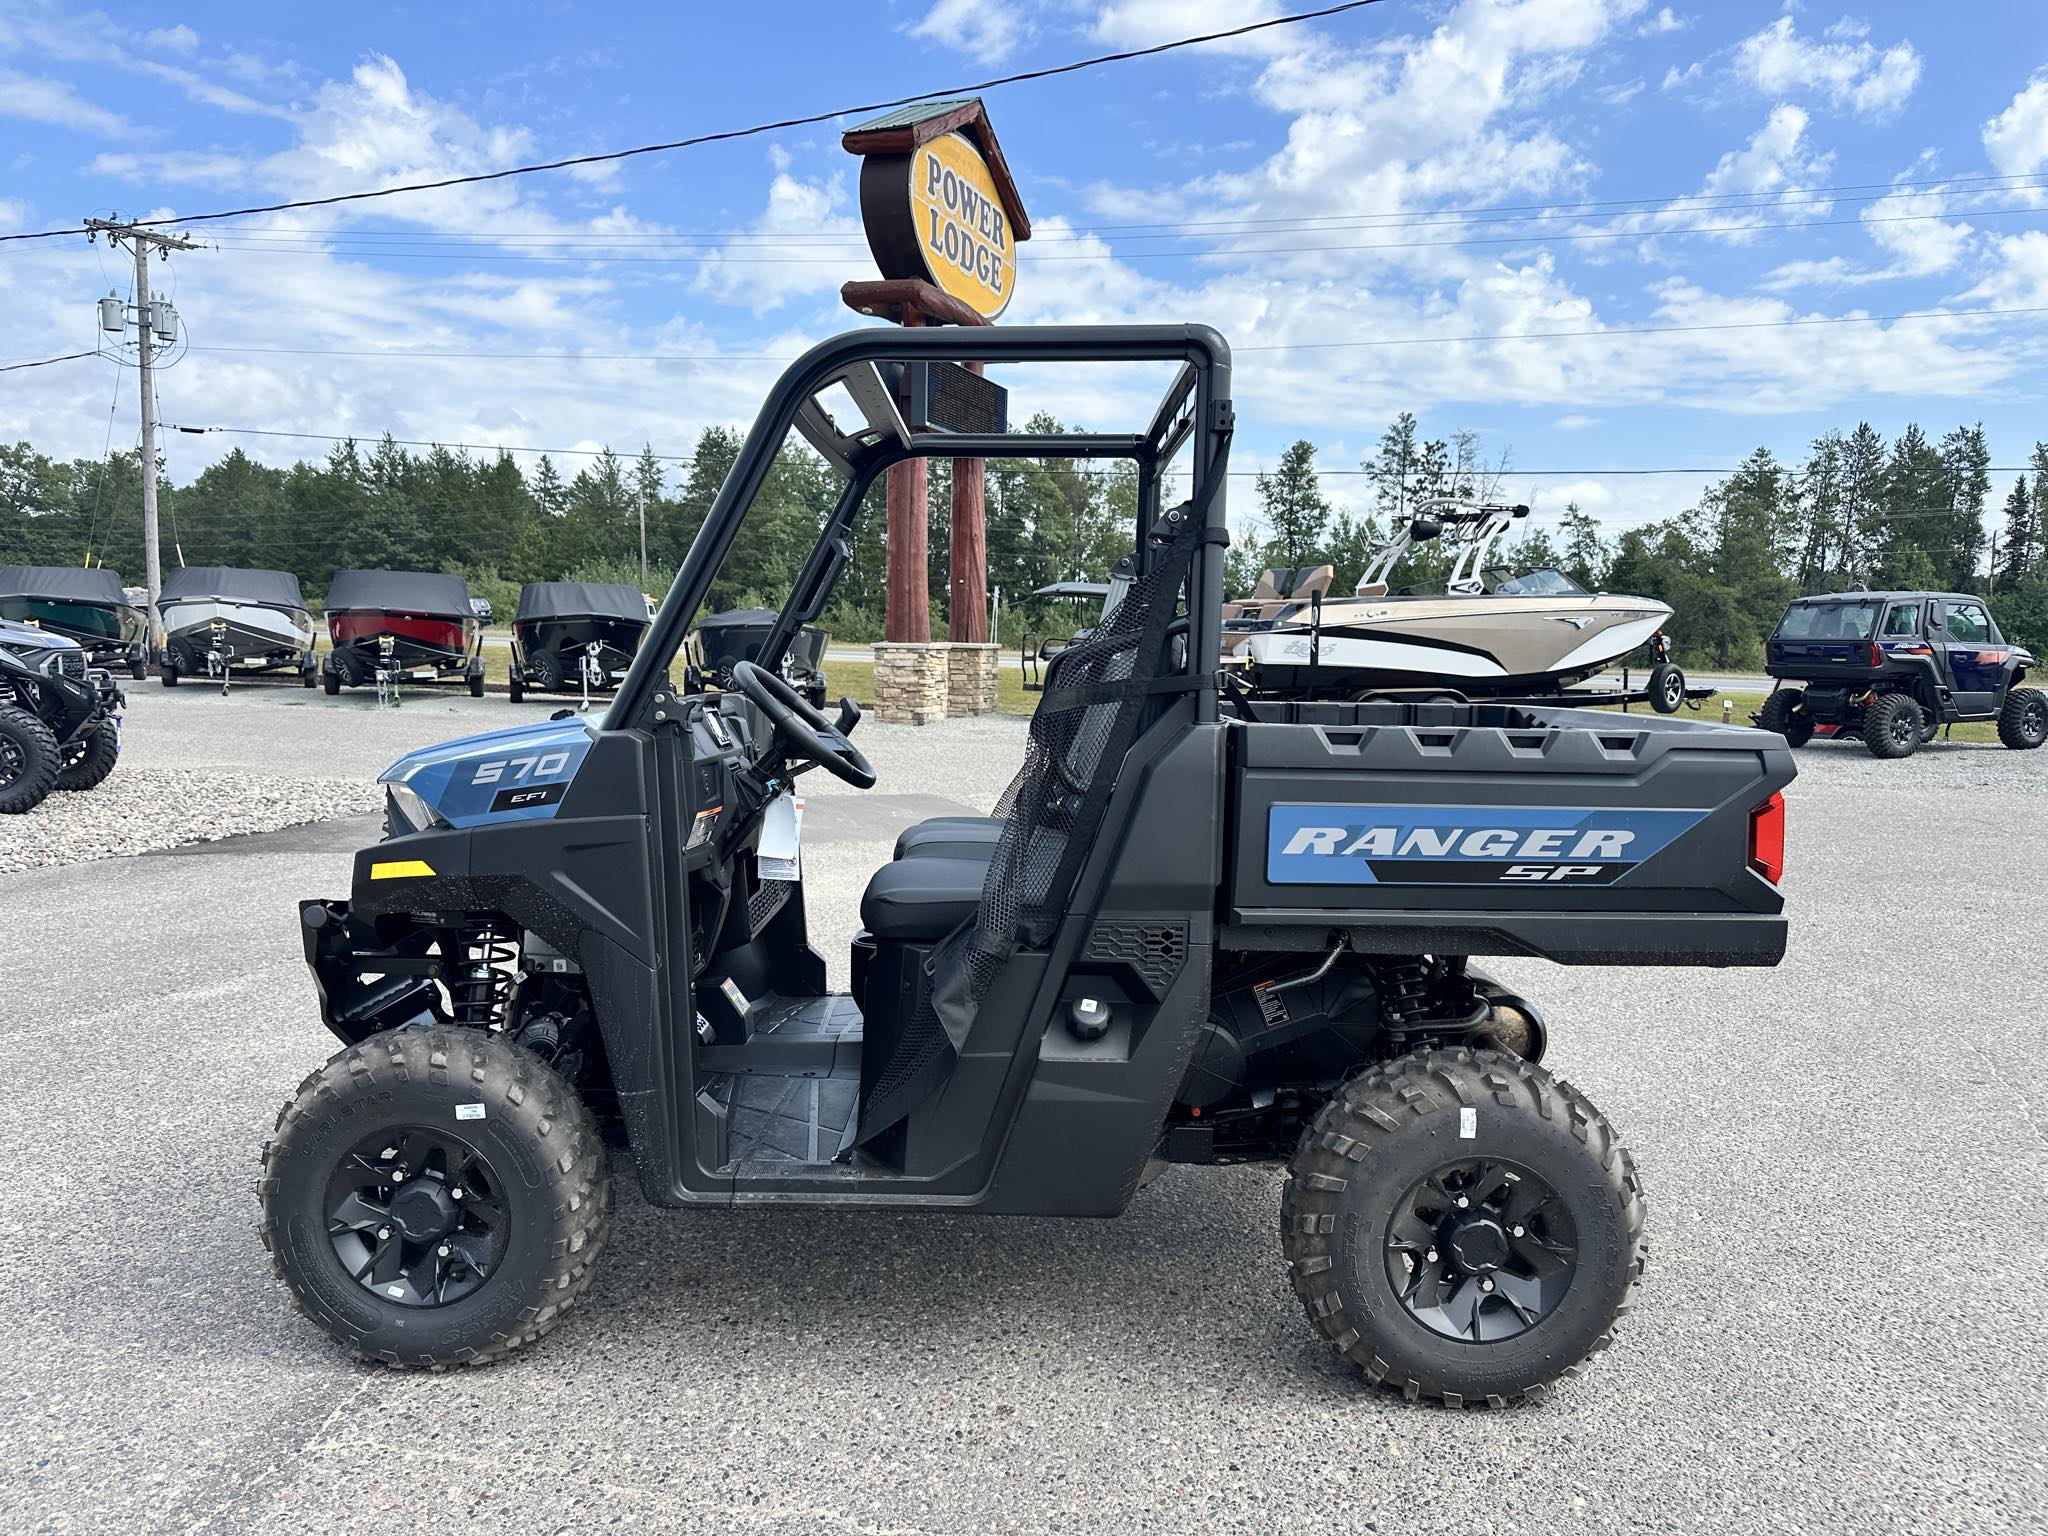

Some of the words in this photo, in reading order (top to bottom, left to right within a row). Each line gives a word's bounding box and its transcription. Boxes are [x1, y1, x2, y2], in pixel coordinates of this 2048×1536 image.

[927, 153, 1005, 251] POWER
[930, 208, 1003, 293] LODGE
[471, 752, 570, 785] 570
[510, 791, 547, 804] EFI
[1281, 827, 1636, 858] RANGER
[1499, 865, 1603, 880] SP
